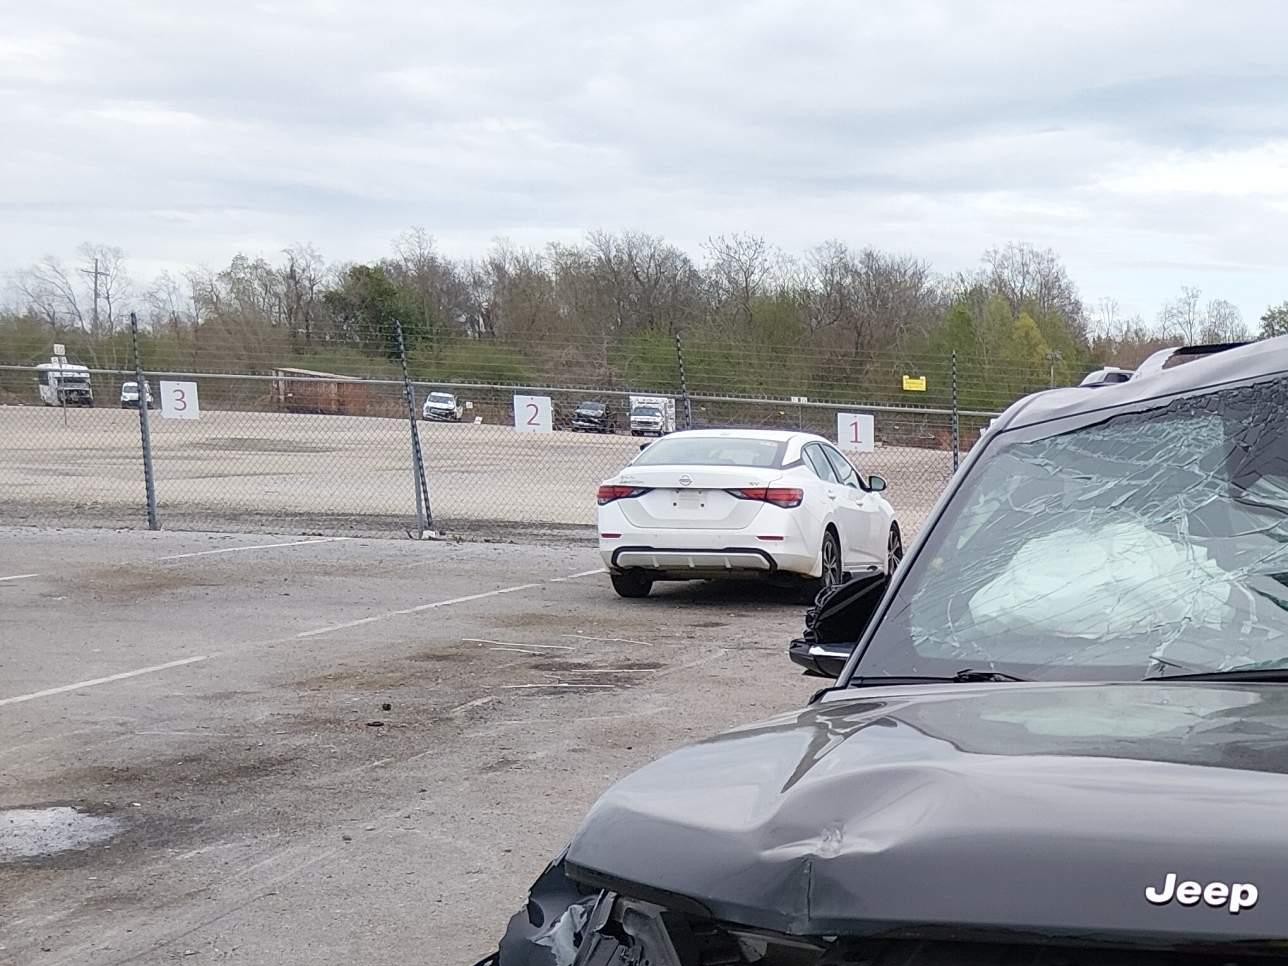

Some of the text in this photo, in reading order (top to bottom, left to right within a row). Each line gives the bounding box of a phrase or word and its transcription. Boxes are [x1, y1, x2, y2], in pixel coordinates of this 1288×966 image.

[173, 389, 187, 411] 3
[526, 403, 540, 426] 2
[849, 421, 863, 443] 1
[1145, 873, 1259, 912] Jeep
